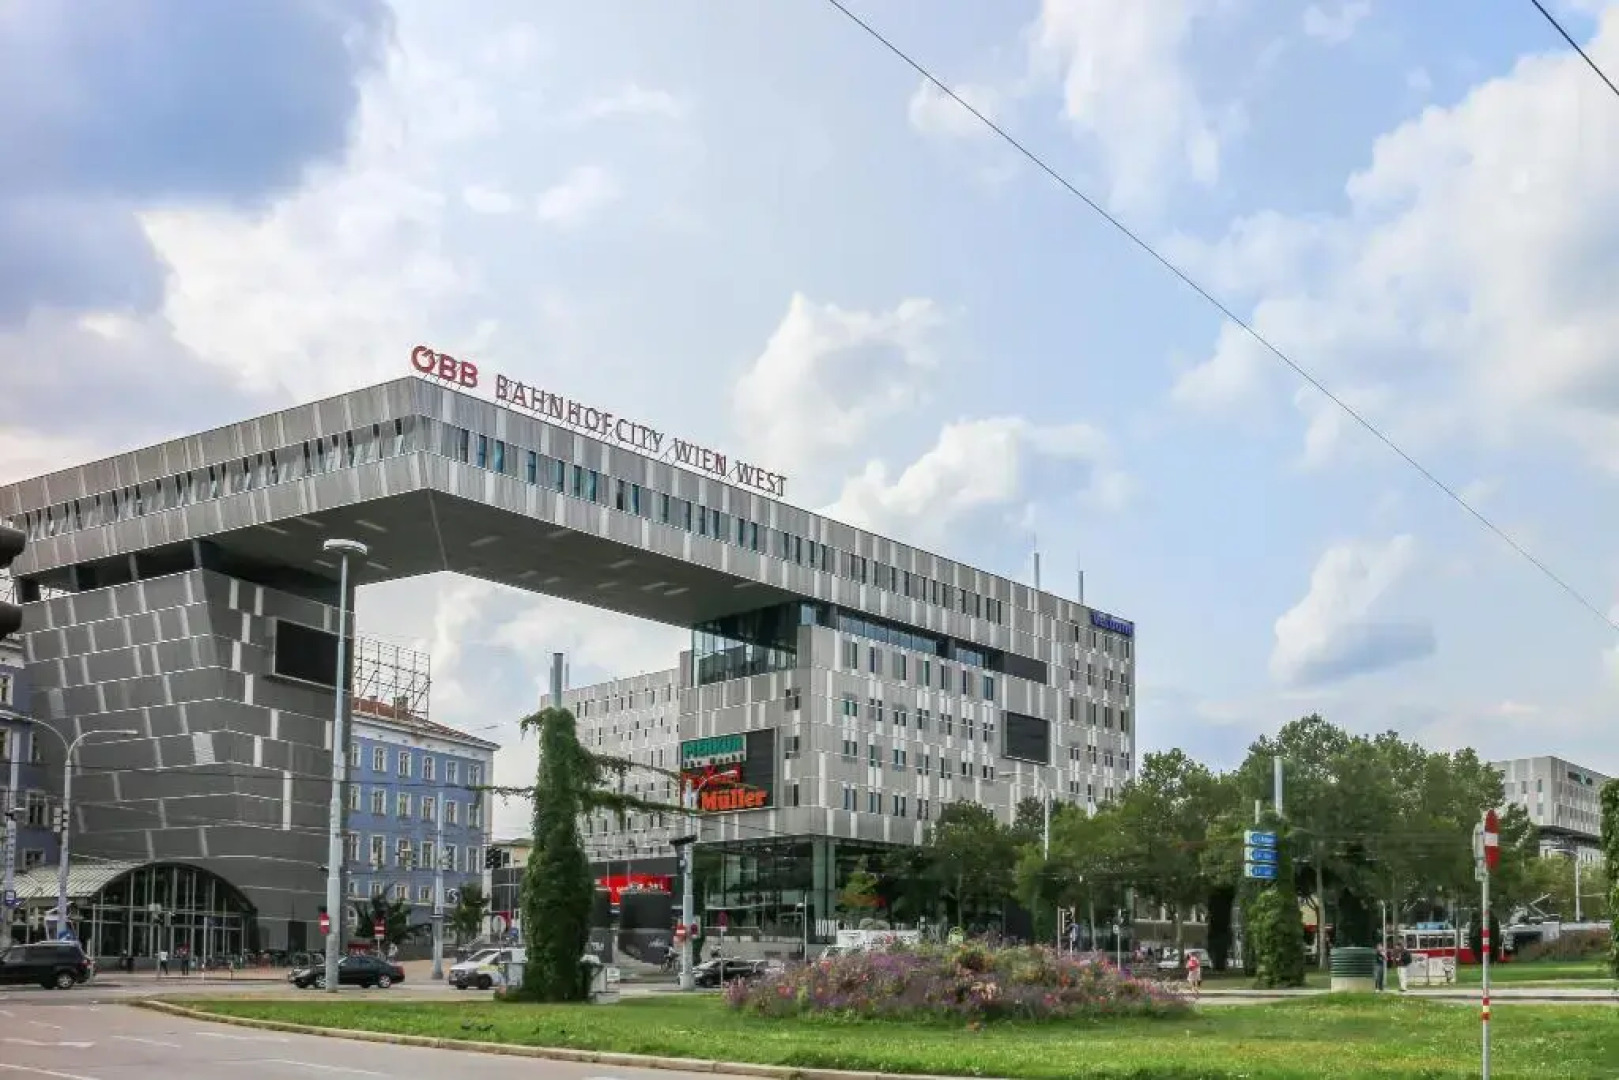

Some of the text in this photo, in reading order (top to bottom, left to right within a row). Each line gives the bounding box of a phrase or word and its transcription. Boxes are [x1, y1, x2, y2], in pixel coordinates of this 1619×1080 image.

[673, 438, 726, 476] WIEN
[736, 460, 787, 497] WEST
[702, 788, 767, 811] Müller
